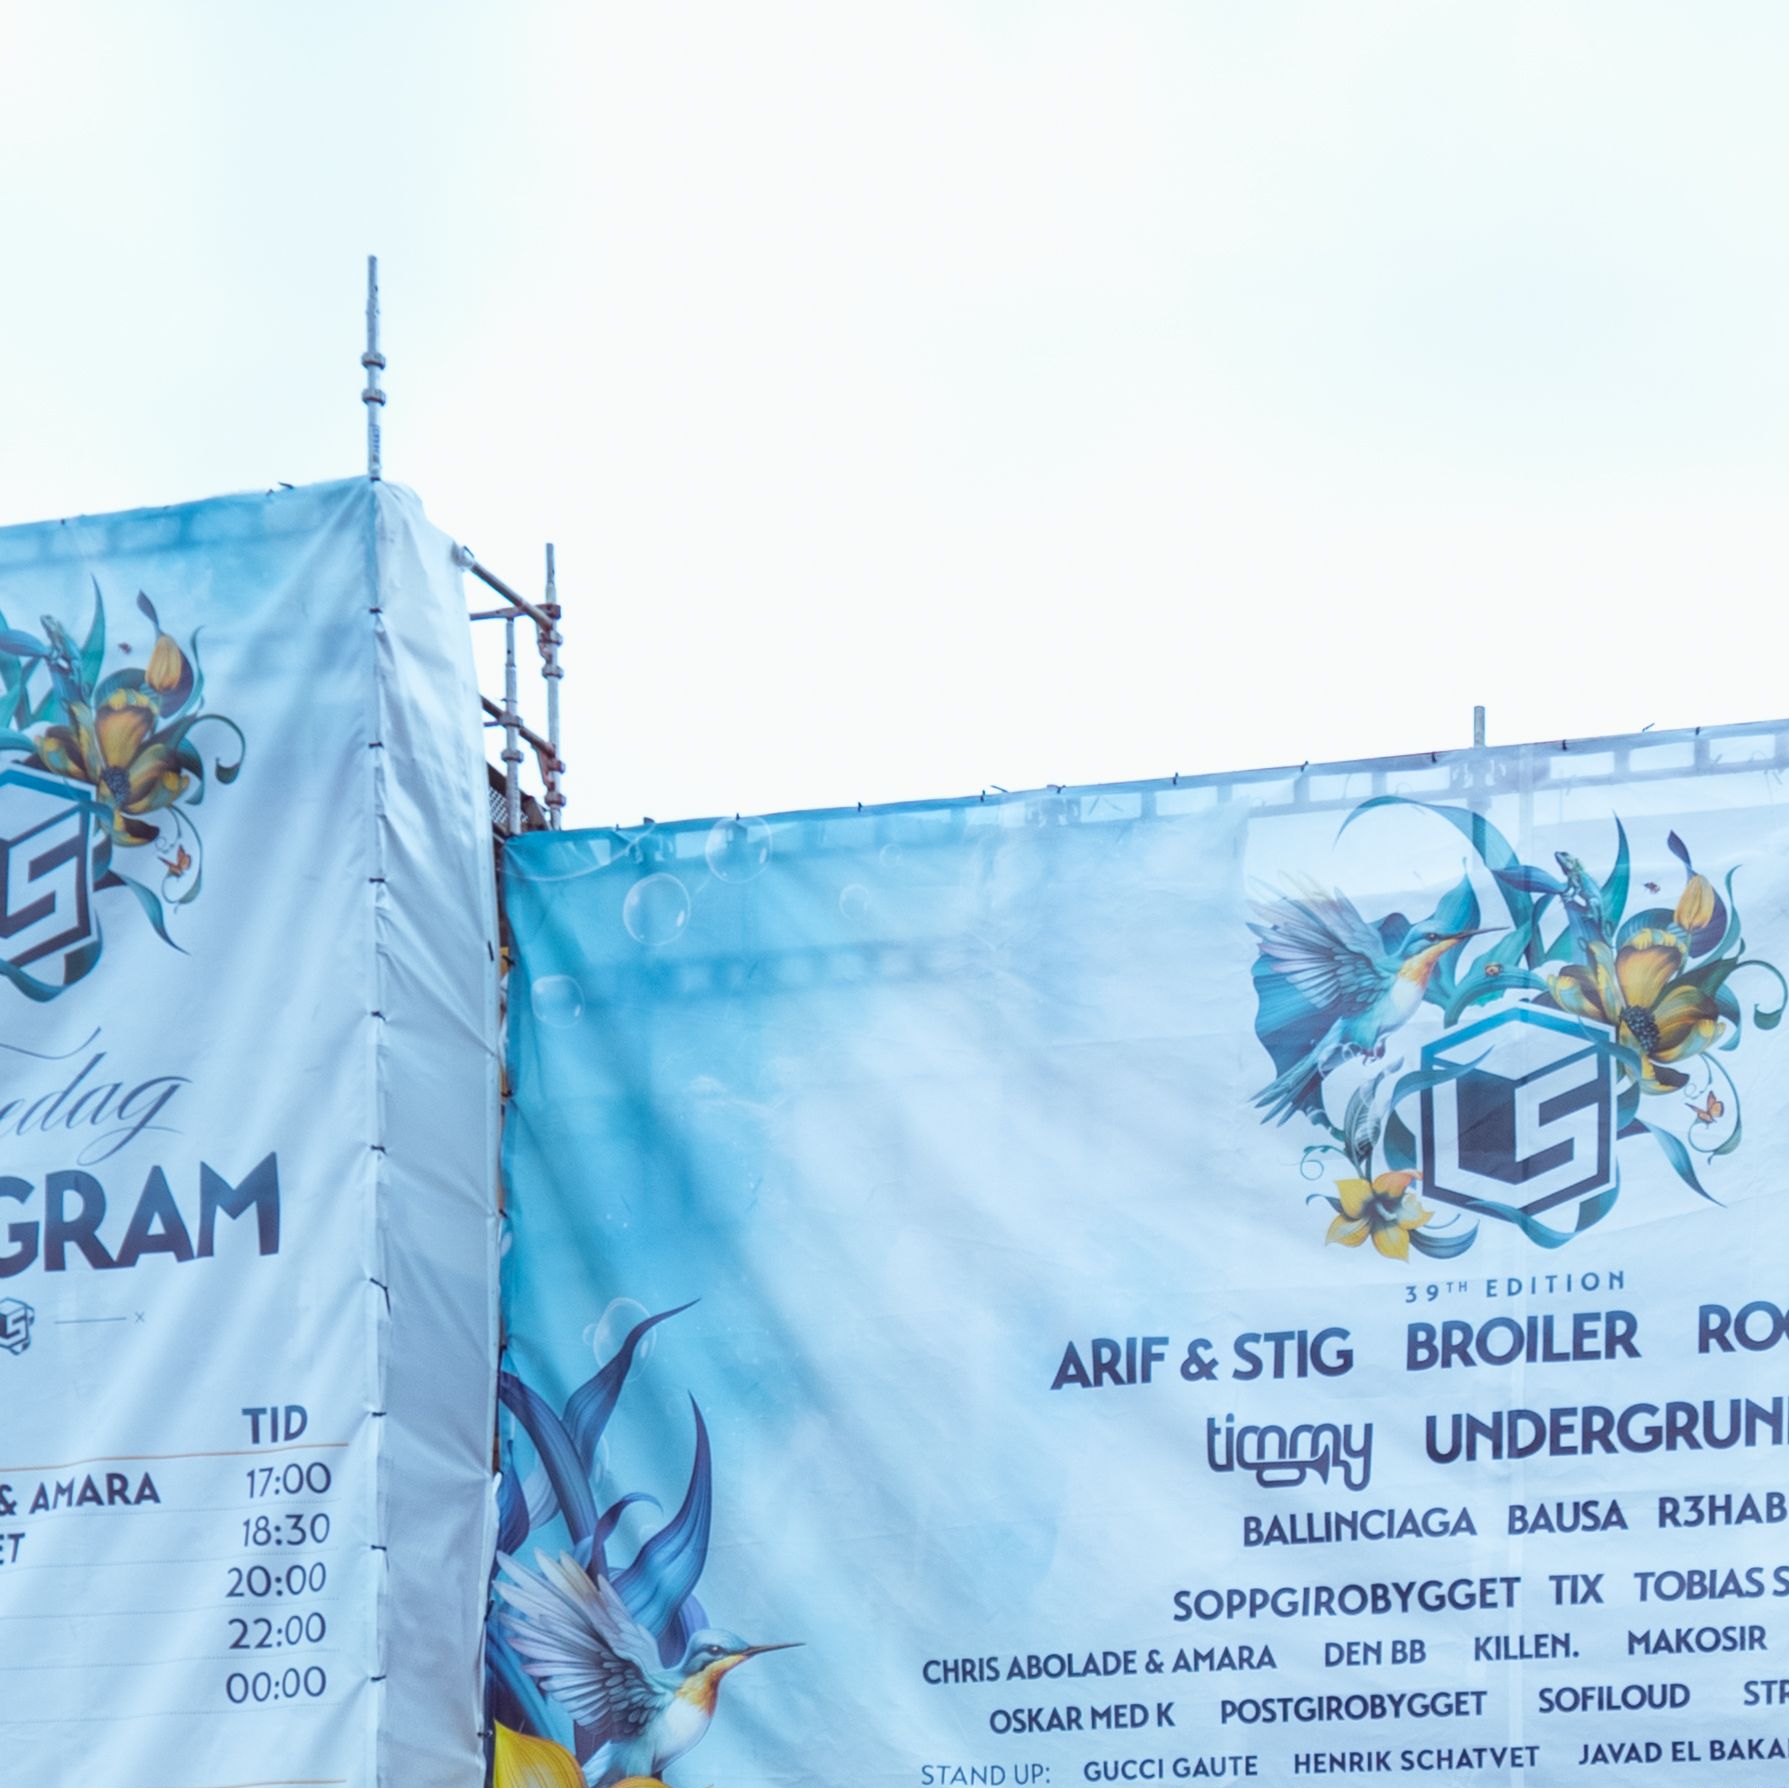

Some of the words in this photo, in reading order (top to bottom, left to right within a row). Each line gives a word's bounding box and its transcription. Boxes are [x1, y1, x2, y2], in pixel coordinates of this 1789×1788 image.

[1486, 1270, 1625, 1298] EDITION
[1050, 1336, 1170, 1391] ARIF
[1180, 1337, 1220, 1382] &
[1232, 1326, 1354, 1381] STIG
[1406, 1309, 1642, 1372] BROILER
[242, 1405, 308, 1445] TID
[29, 1471, 161, 1515] AMARA
[247, 1462, 331, 1500] 17:00
[243, 1512, 330, 1548] 18:30
[1243, 1507, 1478, 1548] BALLINCIAGA
[1508, 1499, 1629, 1536] BAUSA
[1658, 1492, 1788, 1529] R3HAB
[225, 1561, 327, 1599] 20:00
[1173, 1576, 1522, 1623] SOPPGIROBYGGET
[1549, 1573, 1604, 1606] TIX
[1634, 1566, 1765, 1602] TOBIAS
[227, 1611, 327, 1650] 22:00
[922, 1656, 1001, 1686] CHRIS
[1006, 1650, 1138, 1682] ABOLADE
[1145, 1649, 1165, 1675] &
[1172, 1644, 1279, 1674] AMARA
[1324, 1641, 1383, 1668] DEN
[1391, 1639, 1427, 1665] BB
[1474, 1632, 1580, 1662] KILLEN.
[1628, 1625, 1768, 1656] MAKOSIR
[225, 1665, 327, 1704] 00:00
[989, 1706, 1084, 1735] OSKAR
[1090, 1703, 1150, 1730] MED
[1156, 1702, 1176, 1728] K
[1221, 1690, 1487, 1725] POSTGIROBYGGET
[1538, 1682, 1691, 1713] SOFILOUD
[921, 1764, 1006, 1787] STAND
[1013, 1763, 1051, 1785] UP:
[1083, 1757, 1164, 1782] GUCCI
[1172, 1755, 1258, 1779] GAUTE
[1294, 1750, 1392, 1775] HENRIK
[1400, 1745, 1540, 1771] SCHATVET
[1578, 1741, 1663, 1766] JAVAD
[1671, 1740, 1702, 1763] EL
